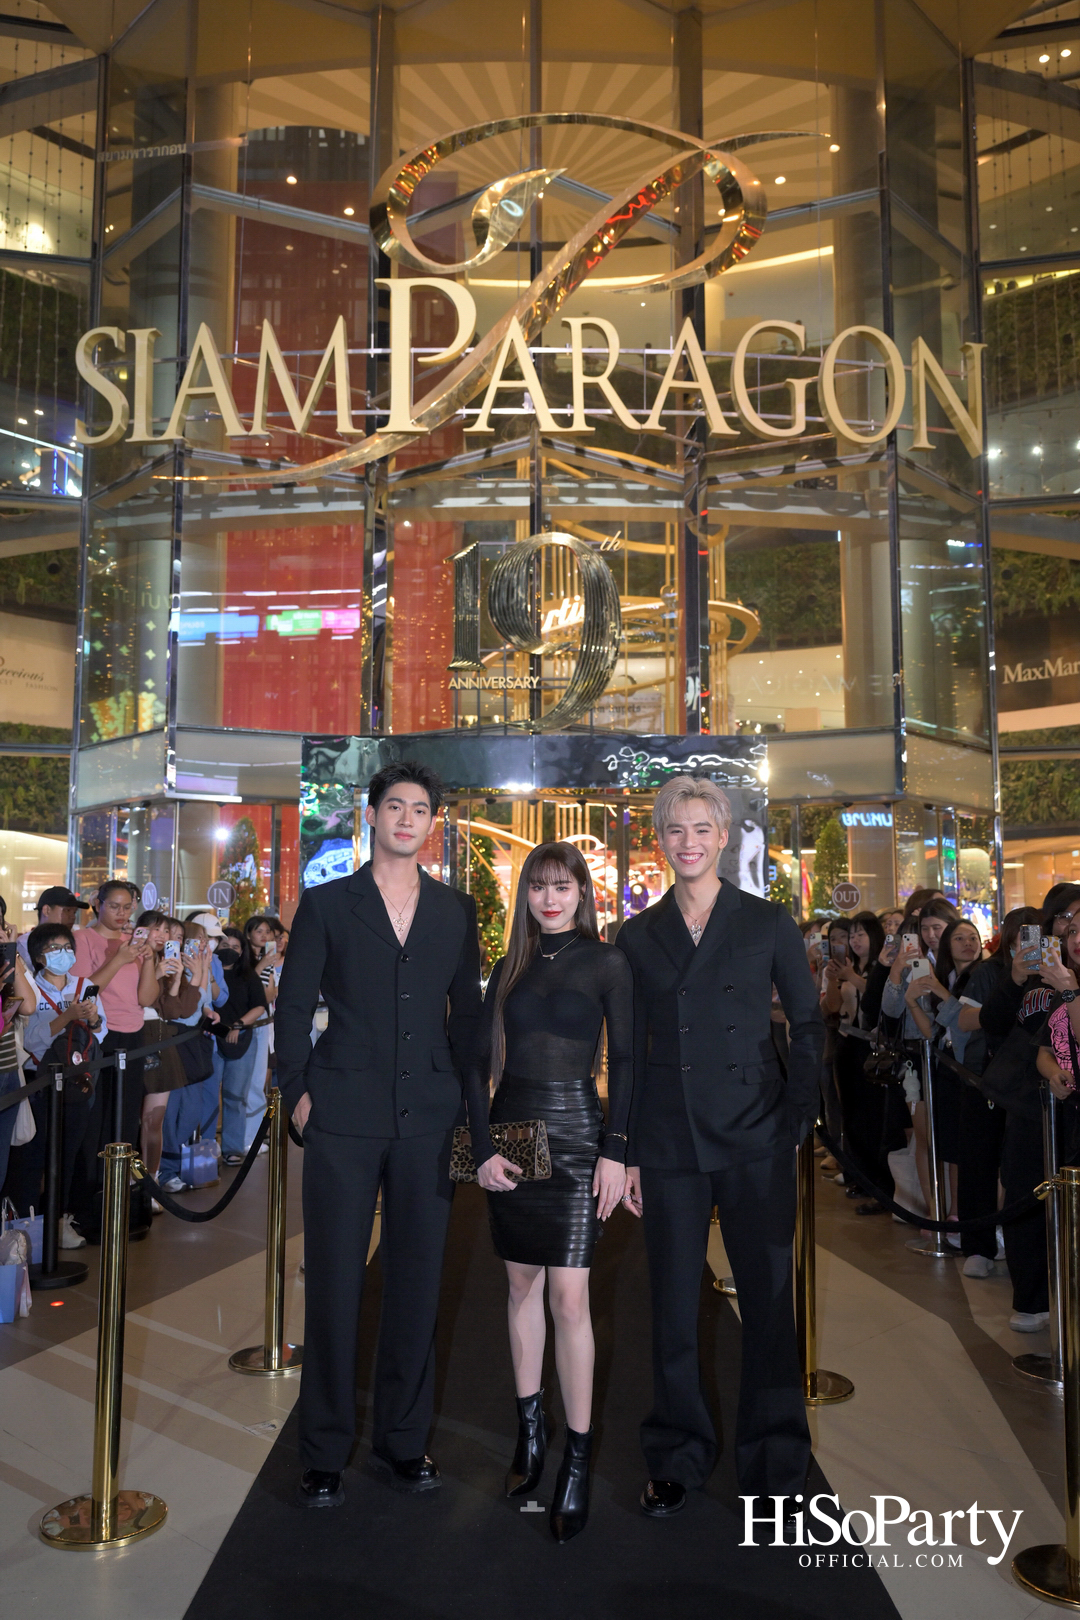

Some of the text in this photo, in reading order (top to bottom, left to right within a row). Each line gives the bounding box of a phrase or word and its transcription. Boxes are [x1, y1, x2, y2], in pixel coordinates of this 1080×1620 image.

[447, 676, 540, 690] ANNIVERSARY
[145, 889, 154, 905] IN
[213, 887, 231, 904] IN
[834, 890, 859, 903] OUT
